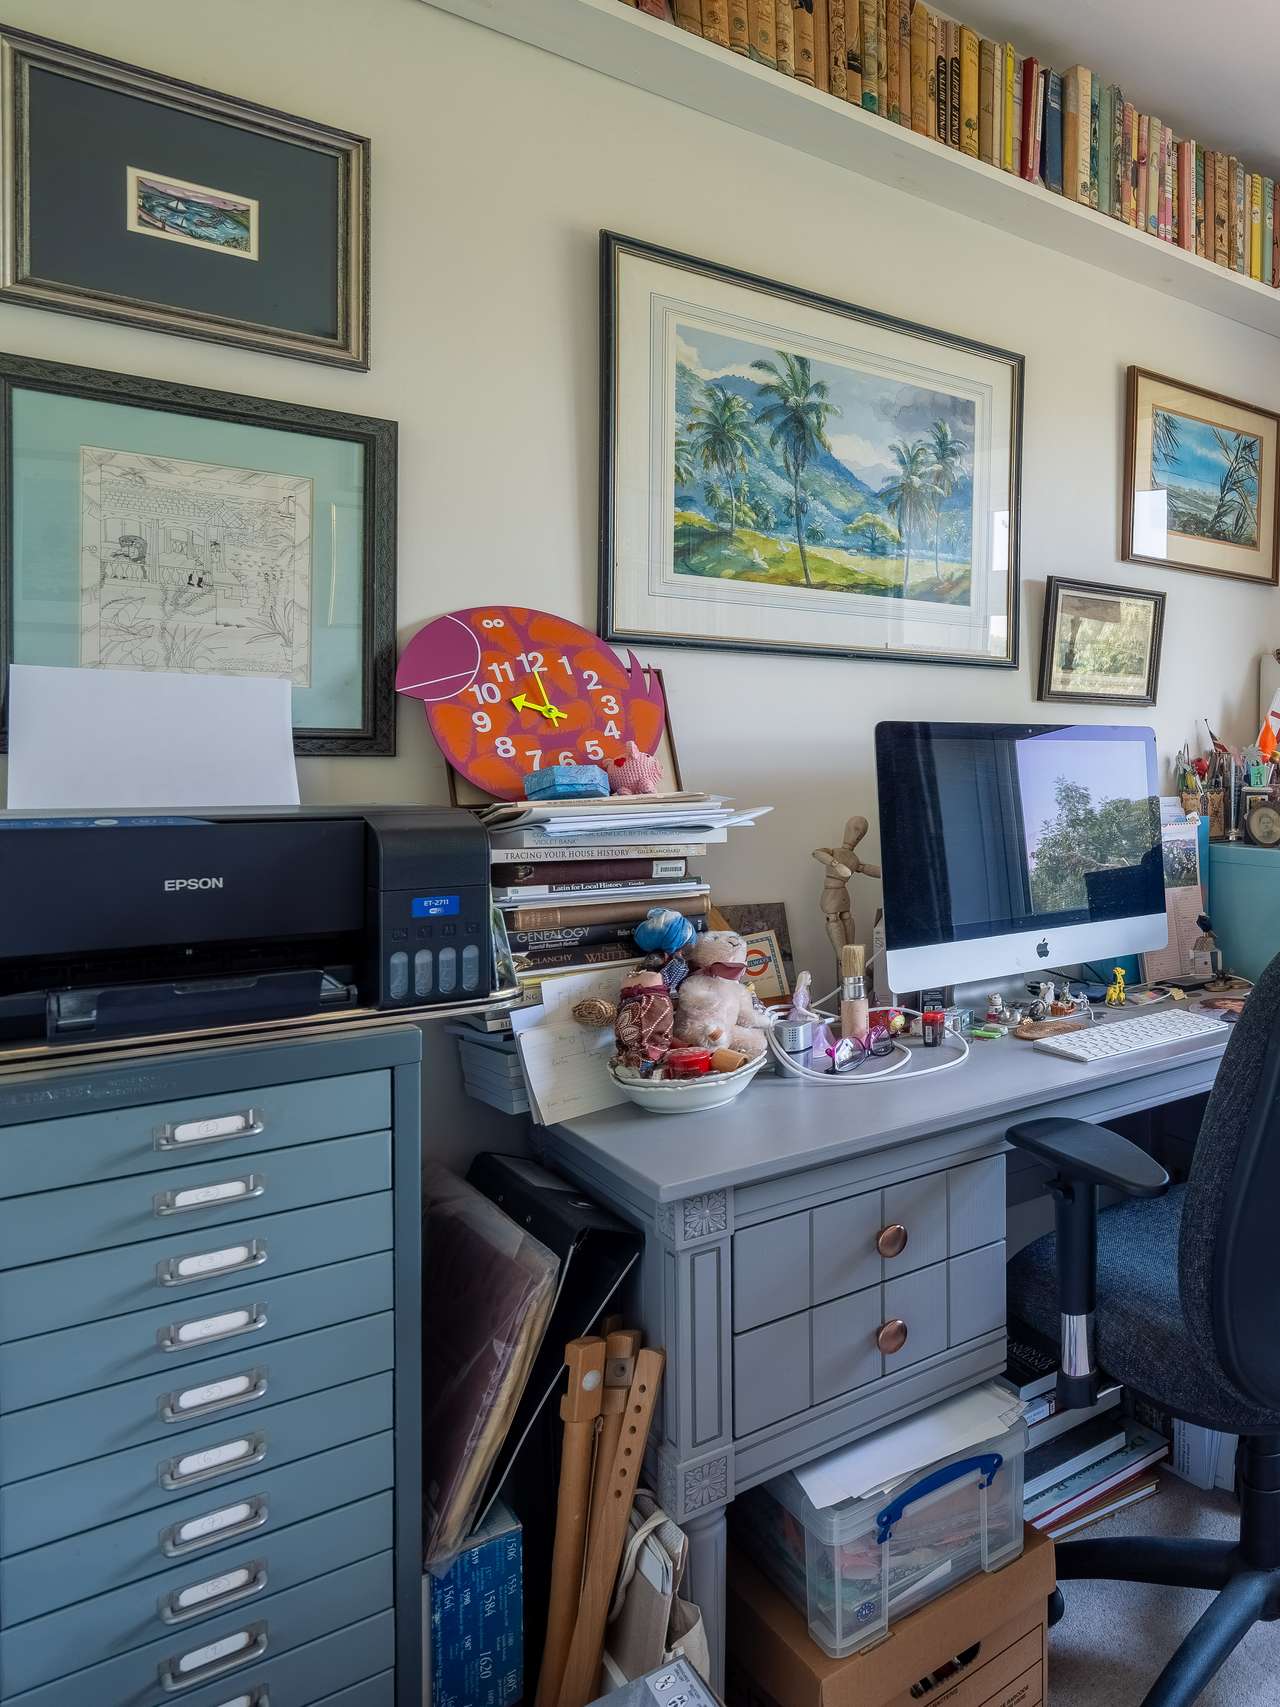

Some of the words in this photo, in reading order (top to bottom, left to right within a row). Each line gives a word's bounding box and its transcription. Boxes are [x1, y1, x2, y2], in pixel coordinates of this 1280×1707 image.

[488, 662, 515, 682] 11
[516, 652, 548, 672] 12
[558, 656, 573, 674] 1
[583, 670, 602, 690] 2
[469, 682, 501, 704] 10
[601, 695, 620, 715] 3
[472, 712, 492, 732] 9
[604, 720, 621, 739] 4
[495, 736, 516, 758] 8
[584, 740, 604, 760] 5
[525, 750, 543, 770] 7
[558, 752, 577, 766] 6
[504, 852, 542, 860] TRACING
[597, 848, 630, 856] HISTORY
[164, 877, 223, 891] EPSON
[517, 927, 590, 943] GENEALOGY
[584, 950, 632, 963] WRITTE
[507, 1538, 517, 1560] 1506
[444, 1586, 455, 1609] 1564
[484, 1590, 496, 1616] 1584
[480, 1651, 493, 1678] 1620
